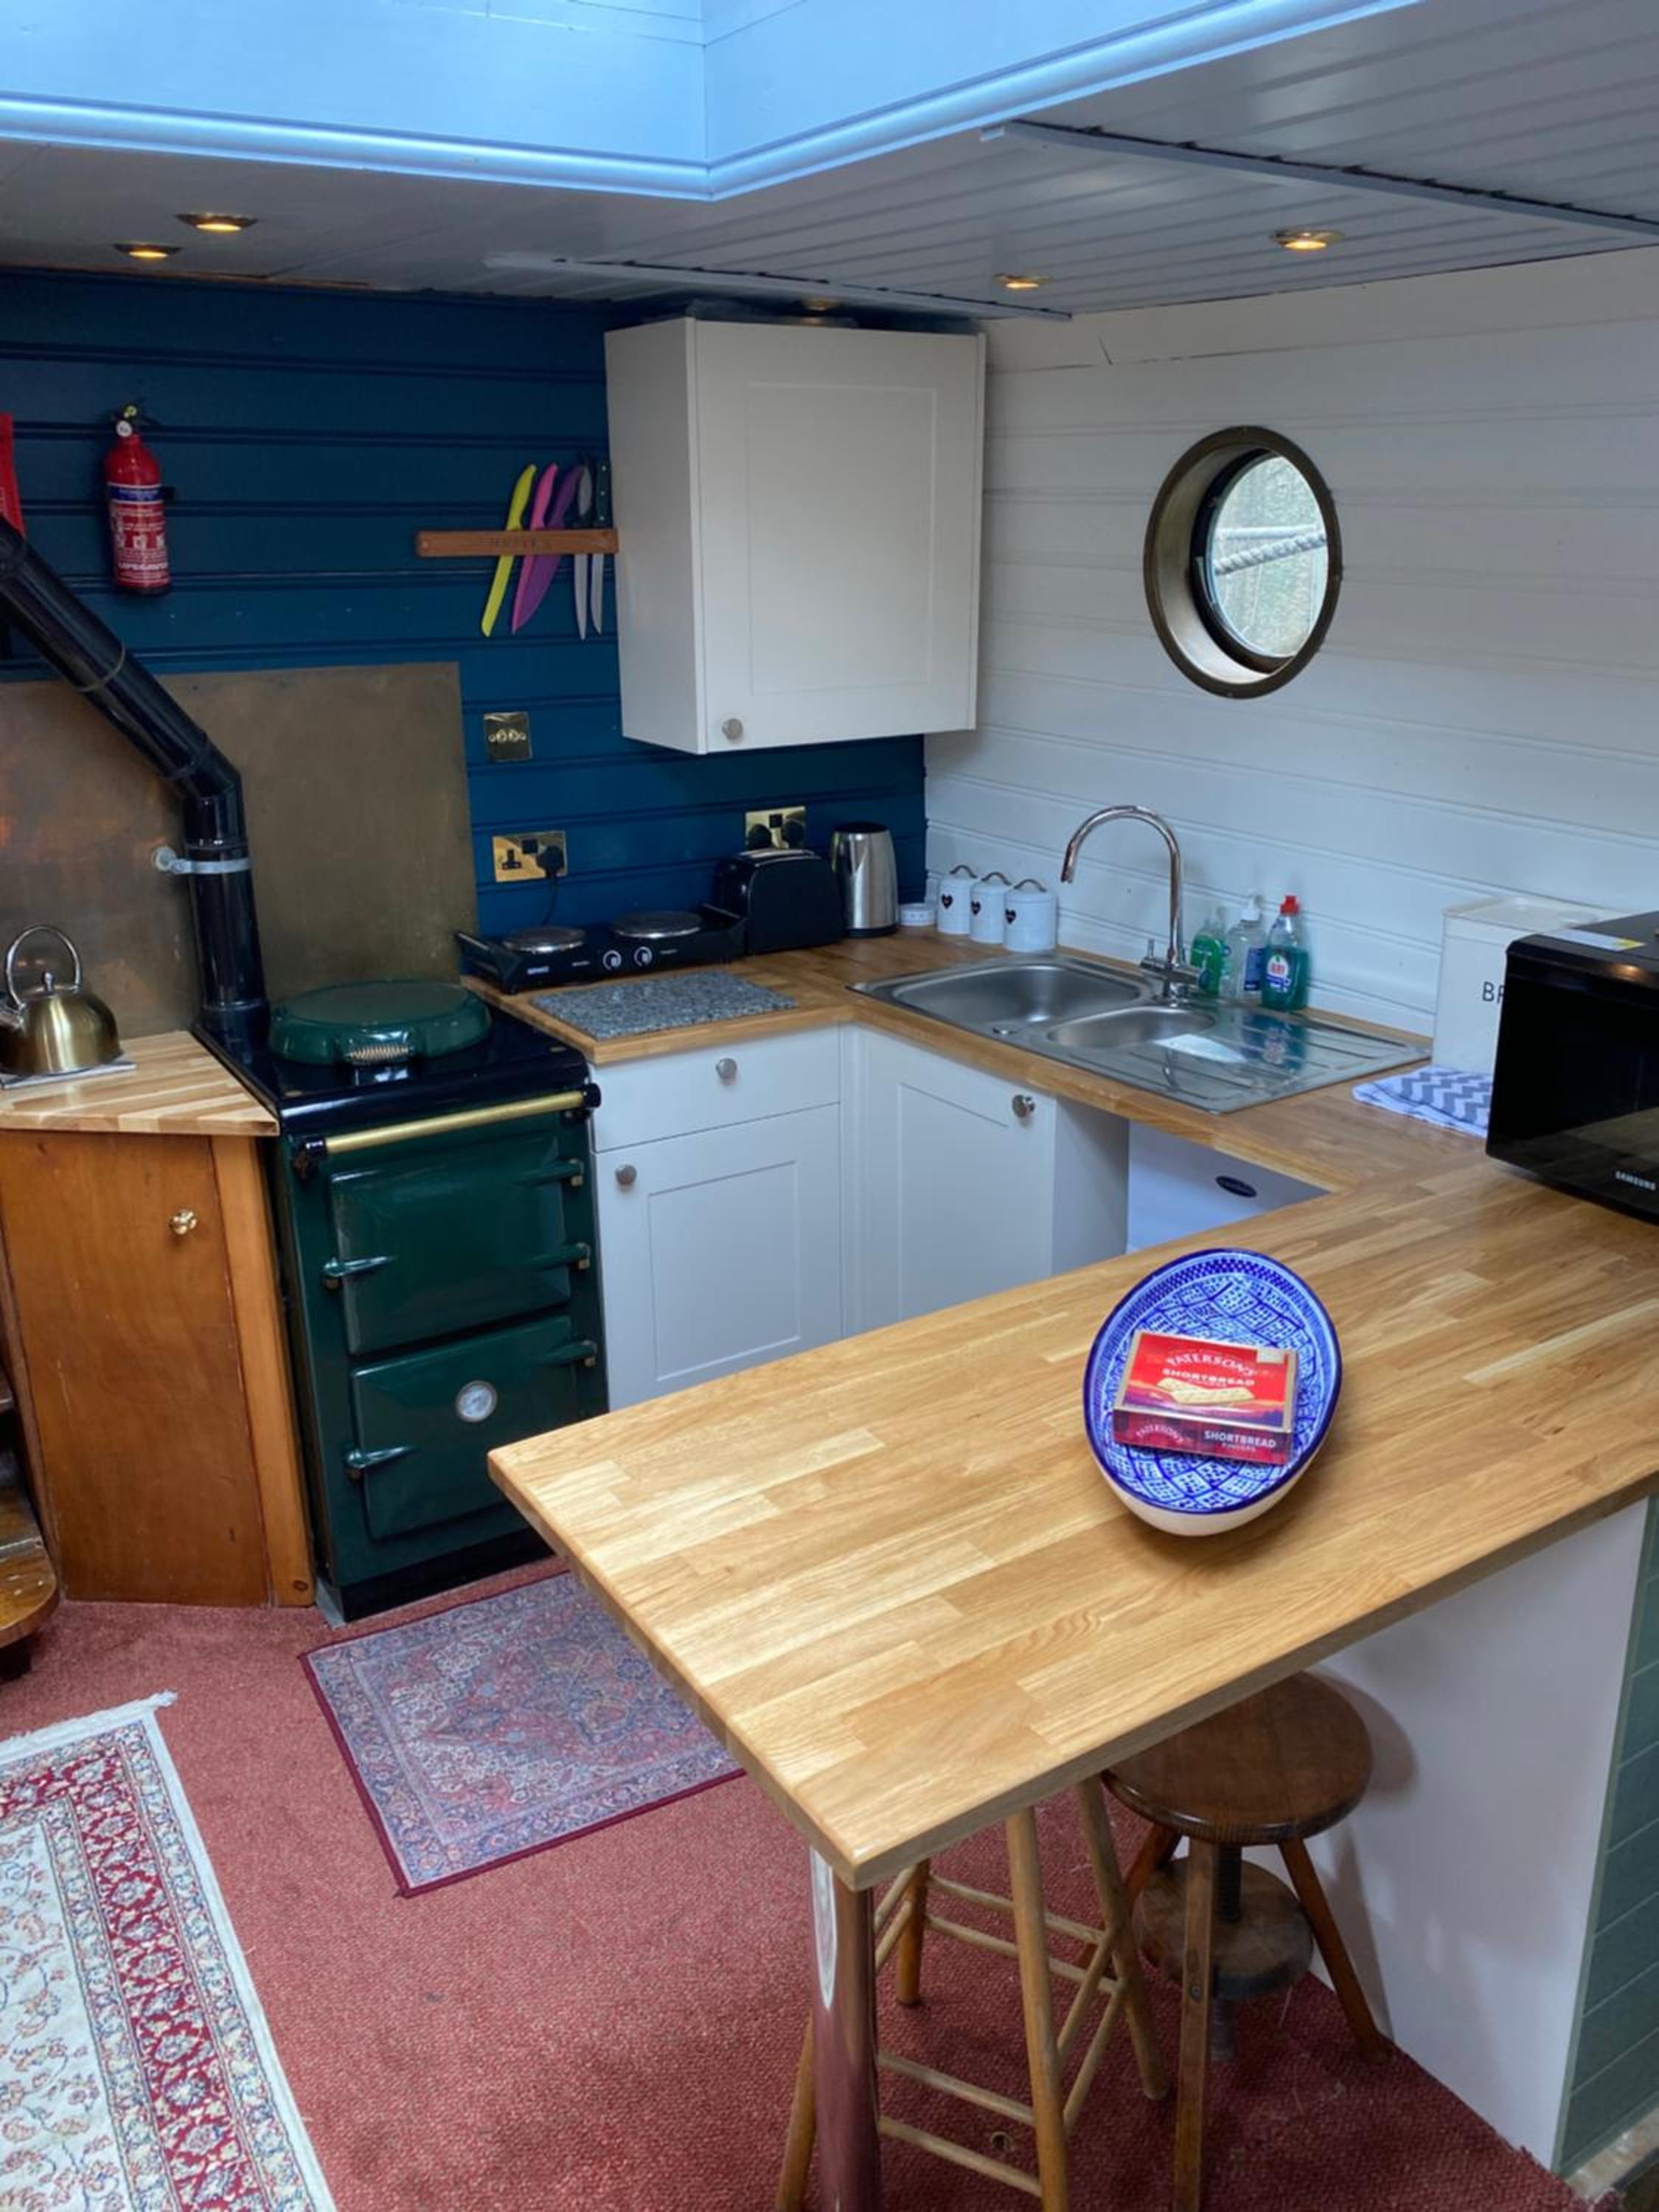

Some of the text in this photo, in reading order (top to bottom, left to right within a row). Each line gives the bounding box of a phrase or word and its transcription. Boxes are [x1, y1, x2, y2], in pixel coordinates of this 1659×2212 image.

[1615, 1170, 1656, 1191] SAMSUNG
[1162, 1368, 1256, 1386] SHORTBREAD
[1204, 1430, 1276, 1448] SHORTBREAD
